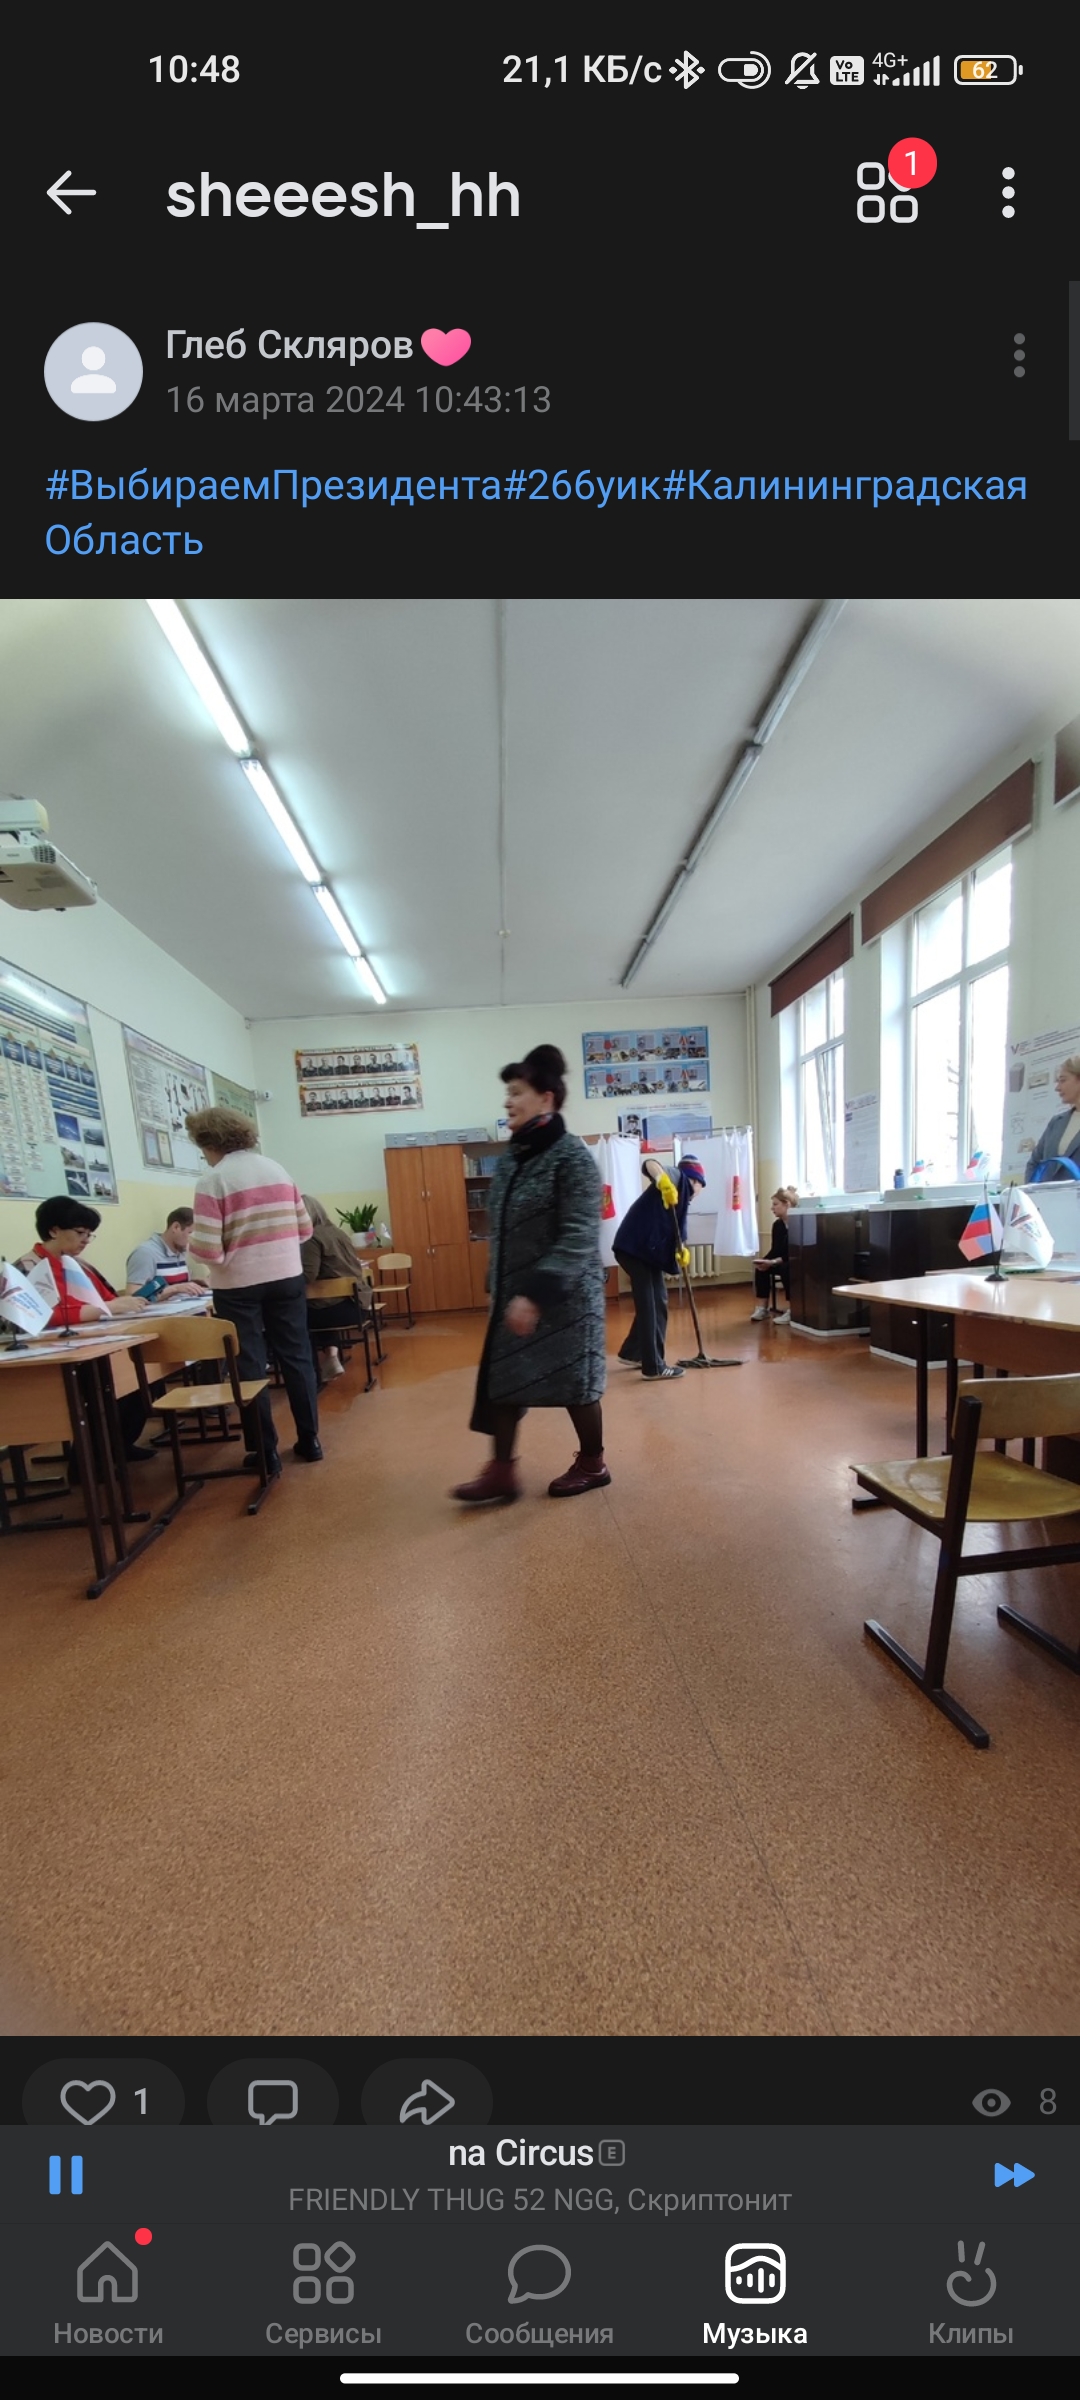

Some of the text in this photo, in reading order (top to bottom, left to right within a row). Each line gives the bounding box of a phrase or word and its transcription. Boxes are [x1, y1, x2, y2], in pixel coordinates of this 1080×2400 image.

[149, 54, 241, 84] 10:48
[502, 54, 663, 89] 21,1 КБ/с
[835, 59, 853, 70] Vo
[871, 52, 909, 68] 4G+
[972, 60, 999, 80] 62
[835, 71, 859, 83] LTE
[904, 150, 917, 177] 1
[166, 171, 520, 230] sheeesh_hh
[167, 327, 414, 367] Глеб Скляров
[167, 385, 551, 420] 16 марта 2024 10:43:13
[45, 467, 1027, 509] #ВыбираемПрезидента#266уик#Калининградская
[45, 521, 204, 556] Область
[134, 2087, 147, 2115] 1
[1039, 2087, 1057, 2115] 8
[449, 2137, 594, 2167] na Circus
[289, 2187, 793, 2217] FRIENDLY THUG 52 NGG, Скриптонит
[54, 2322, 163, 2344] Новости
[265, 2322, 381, 2350] Сервисы
[465, 2321, 614, 2349] Сообщения
[703, 2322, 808, 2350] Музыка
[929, 2322, 1013, 2344] Клипы
